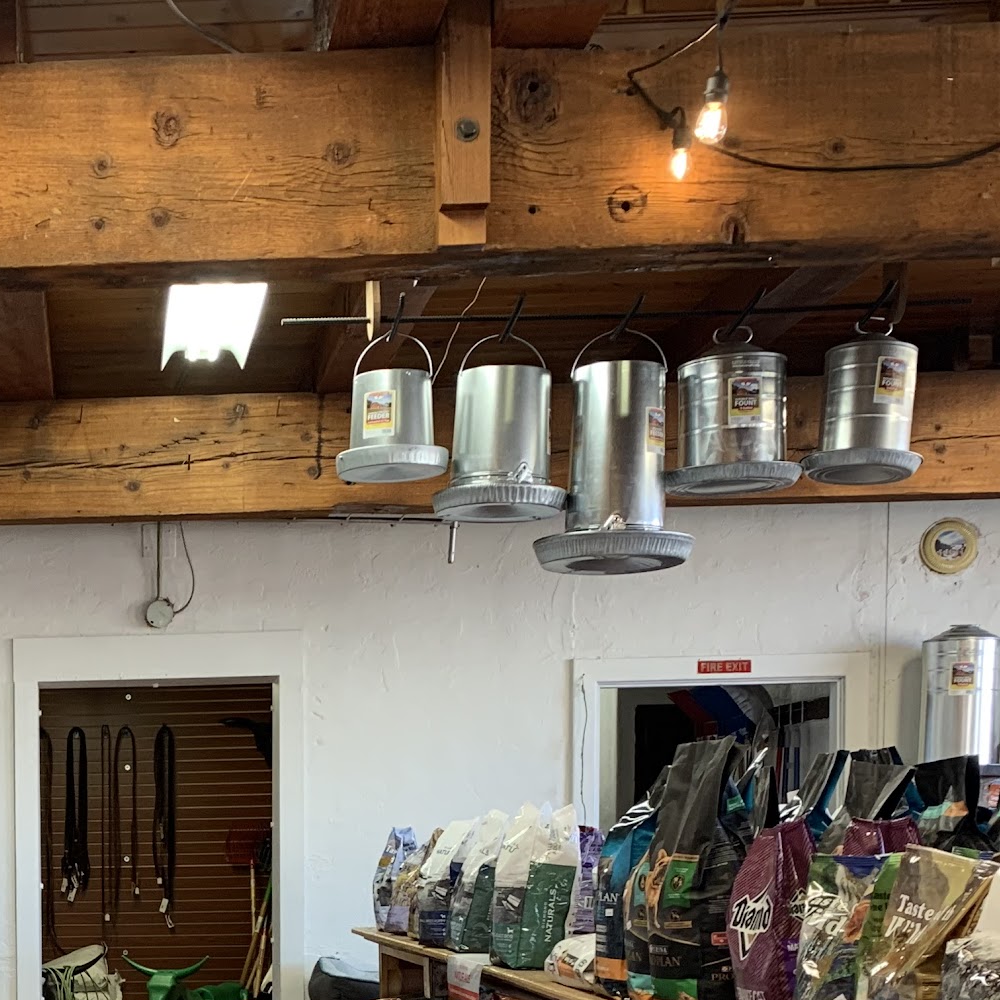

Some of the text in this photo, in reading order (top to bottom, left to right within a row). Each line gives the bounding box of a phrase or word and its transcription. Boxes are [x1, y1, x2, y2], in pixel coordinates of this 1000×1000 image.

[700, 661, 749, 672] FIRE EXIT
[544, 887, 557, 943] NATURALS
[897, 893, 935, 921] Taste
